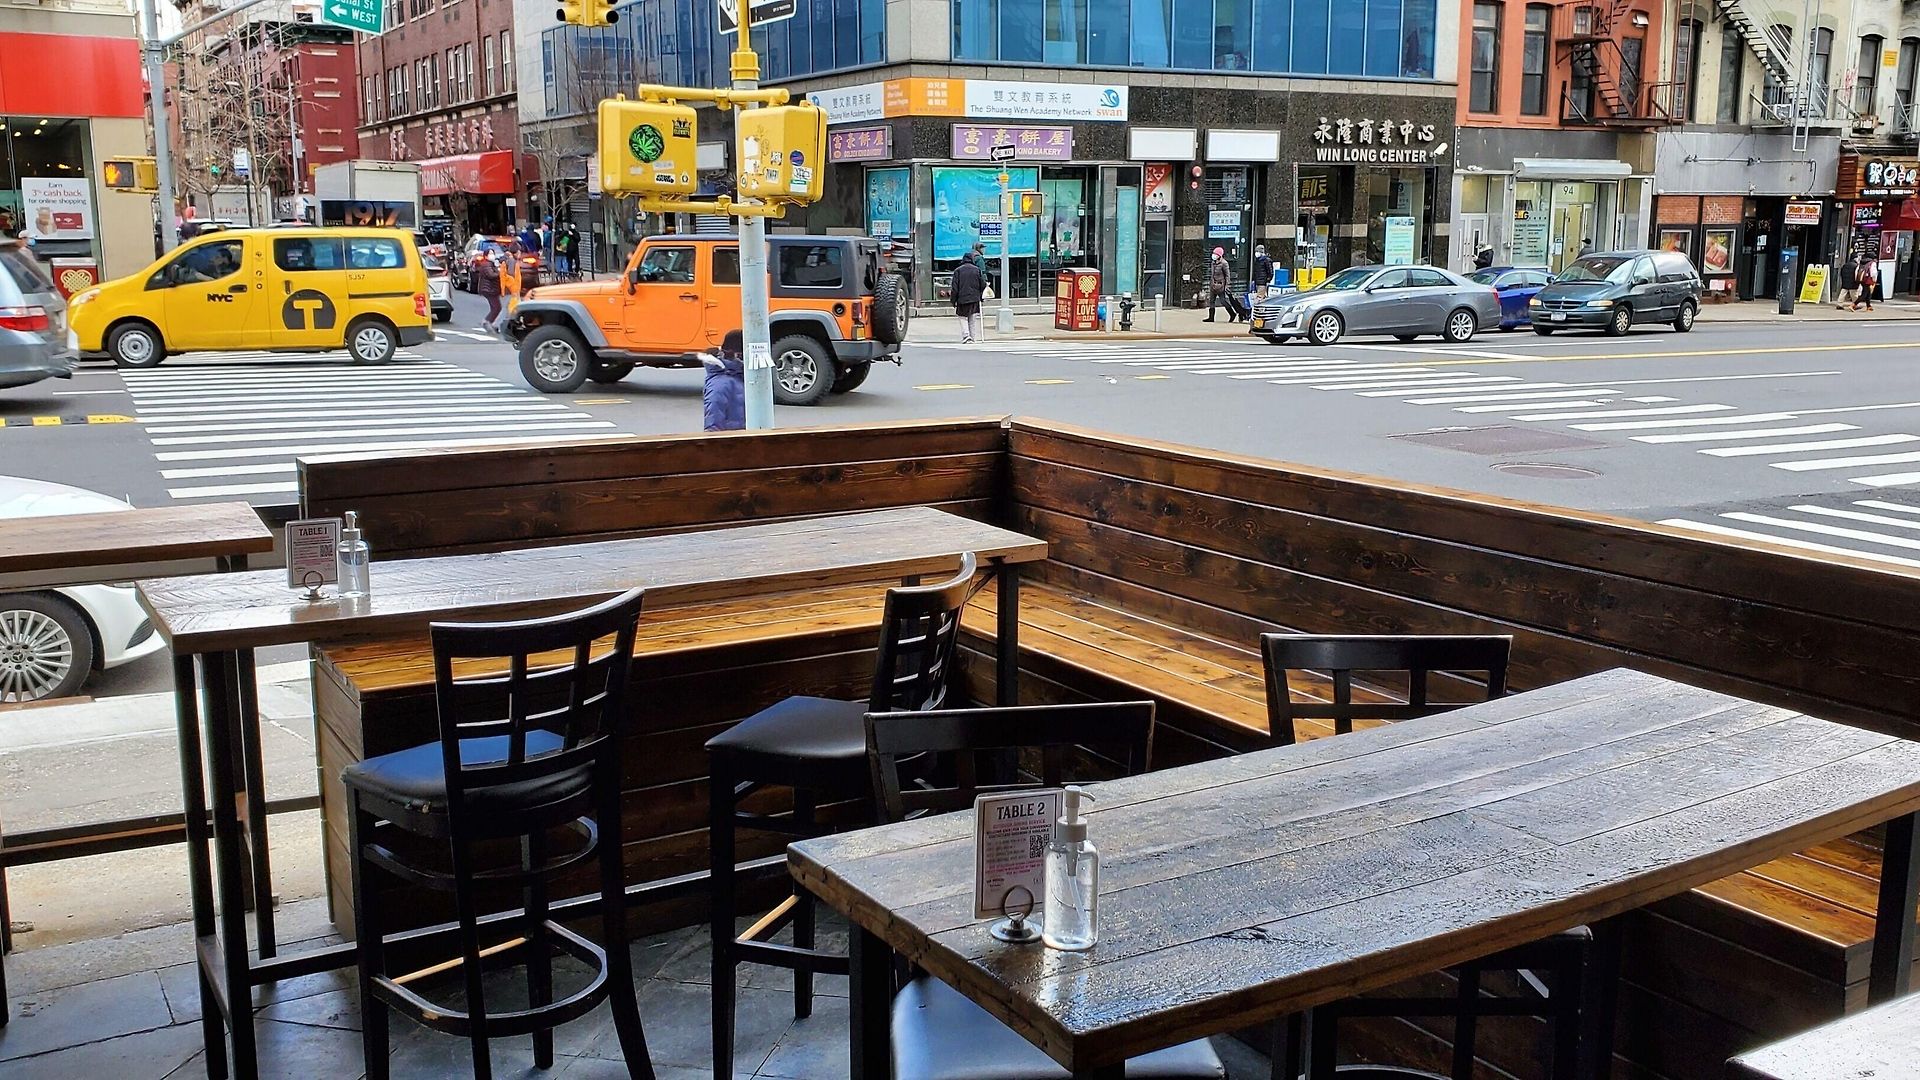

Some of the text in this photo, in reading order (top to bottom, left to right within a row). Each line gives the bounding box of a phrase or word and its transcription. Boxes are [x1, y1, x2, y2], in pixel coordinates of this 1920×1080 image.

[363, 0, 374, 10] St
[351, 9, 377, 24] WEST
[993, 90, 1073, 104] 雙文教育系統
[971, 105, 1092, 117] The Shuang Wen Academy Network
[1096, 109, 1123, 117] swan
[963, 128, 1066, 146] 富豪餅屋
[1314, 117, 1435, 145] 永隆商業中心
[833, 131, 884, 149] 富豪餅屋
[1016, 147, 1062, 156] KING BAKERY
[1316, 148, 1427, 162] WIN LONG CENTER
[43, 189, 62, 197] cash
[63, 189, 82, 197] back
[1563, 185, 1574, 195] 94
[207, 293, 233, 303] NYC
[1076, 304, 1096, 316] LOVE
[299, 527, 323, 536] TABLE
[996, 802, 1045, 820] TABLE 2
